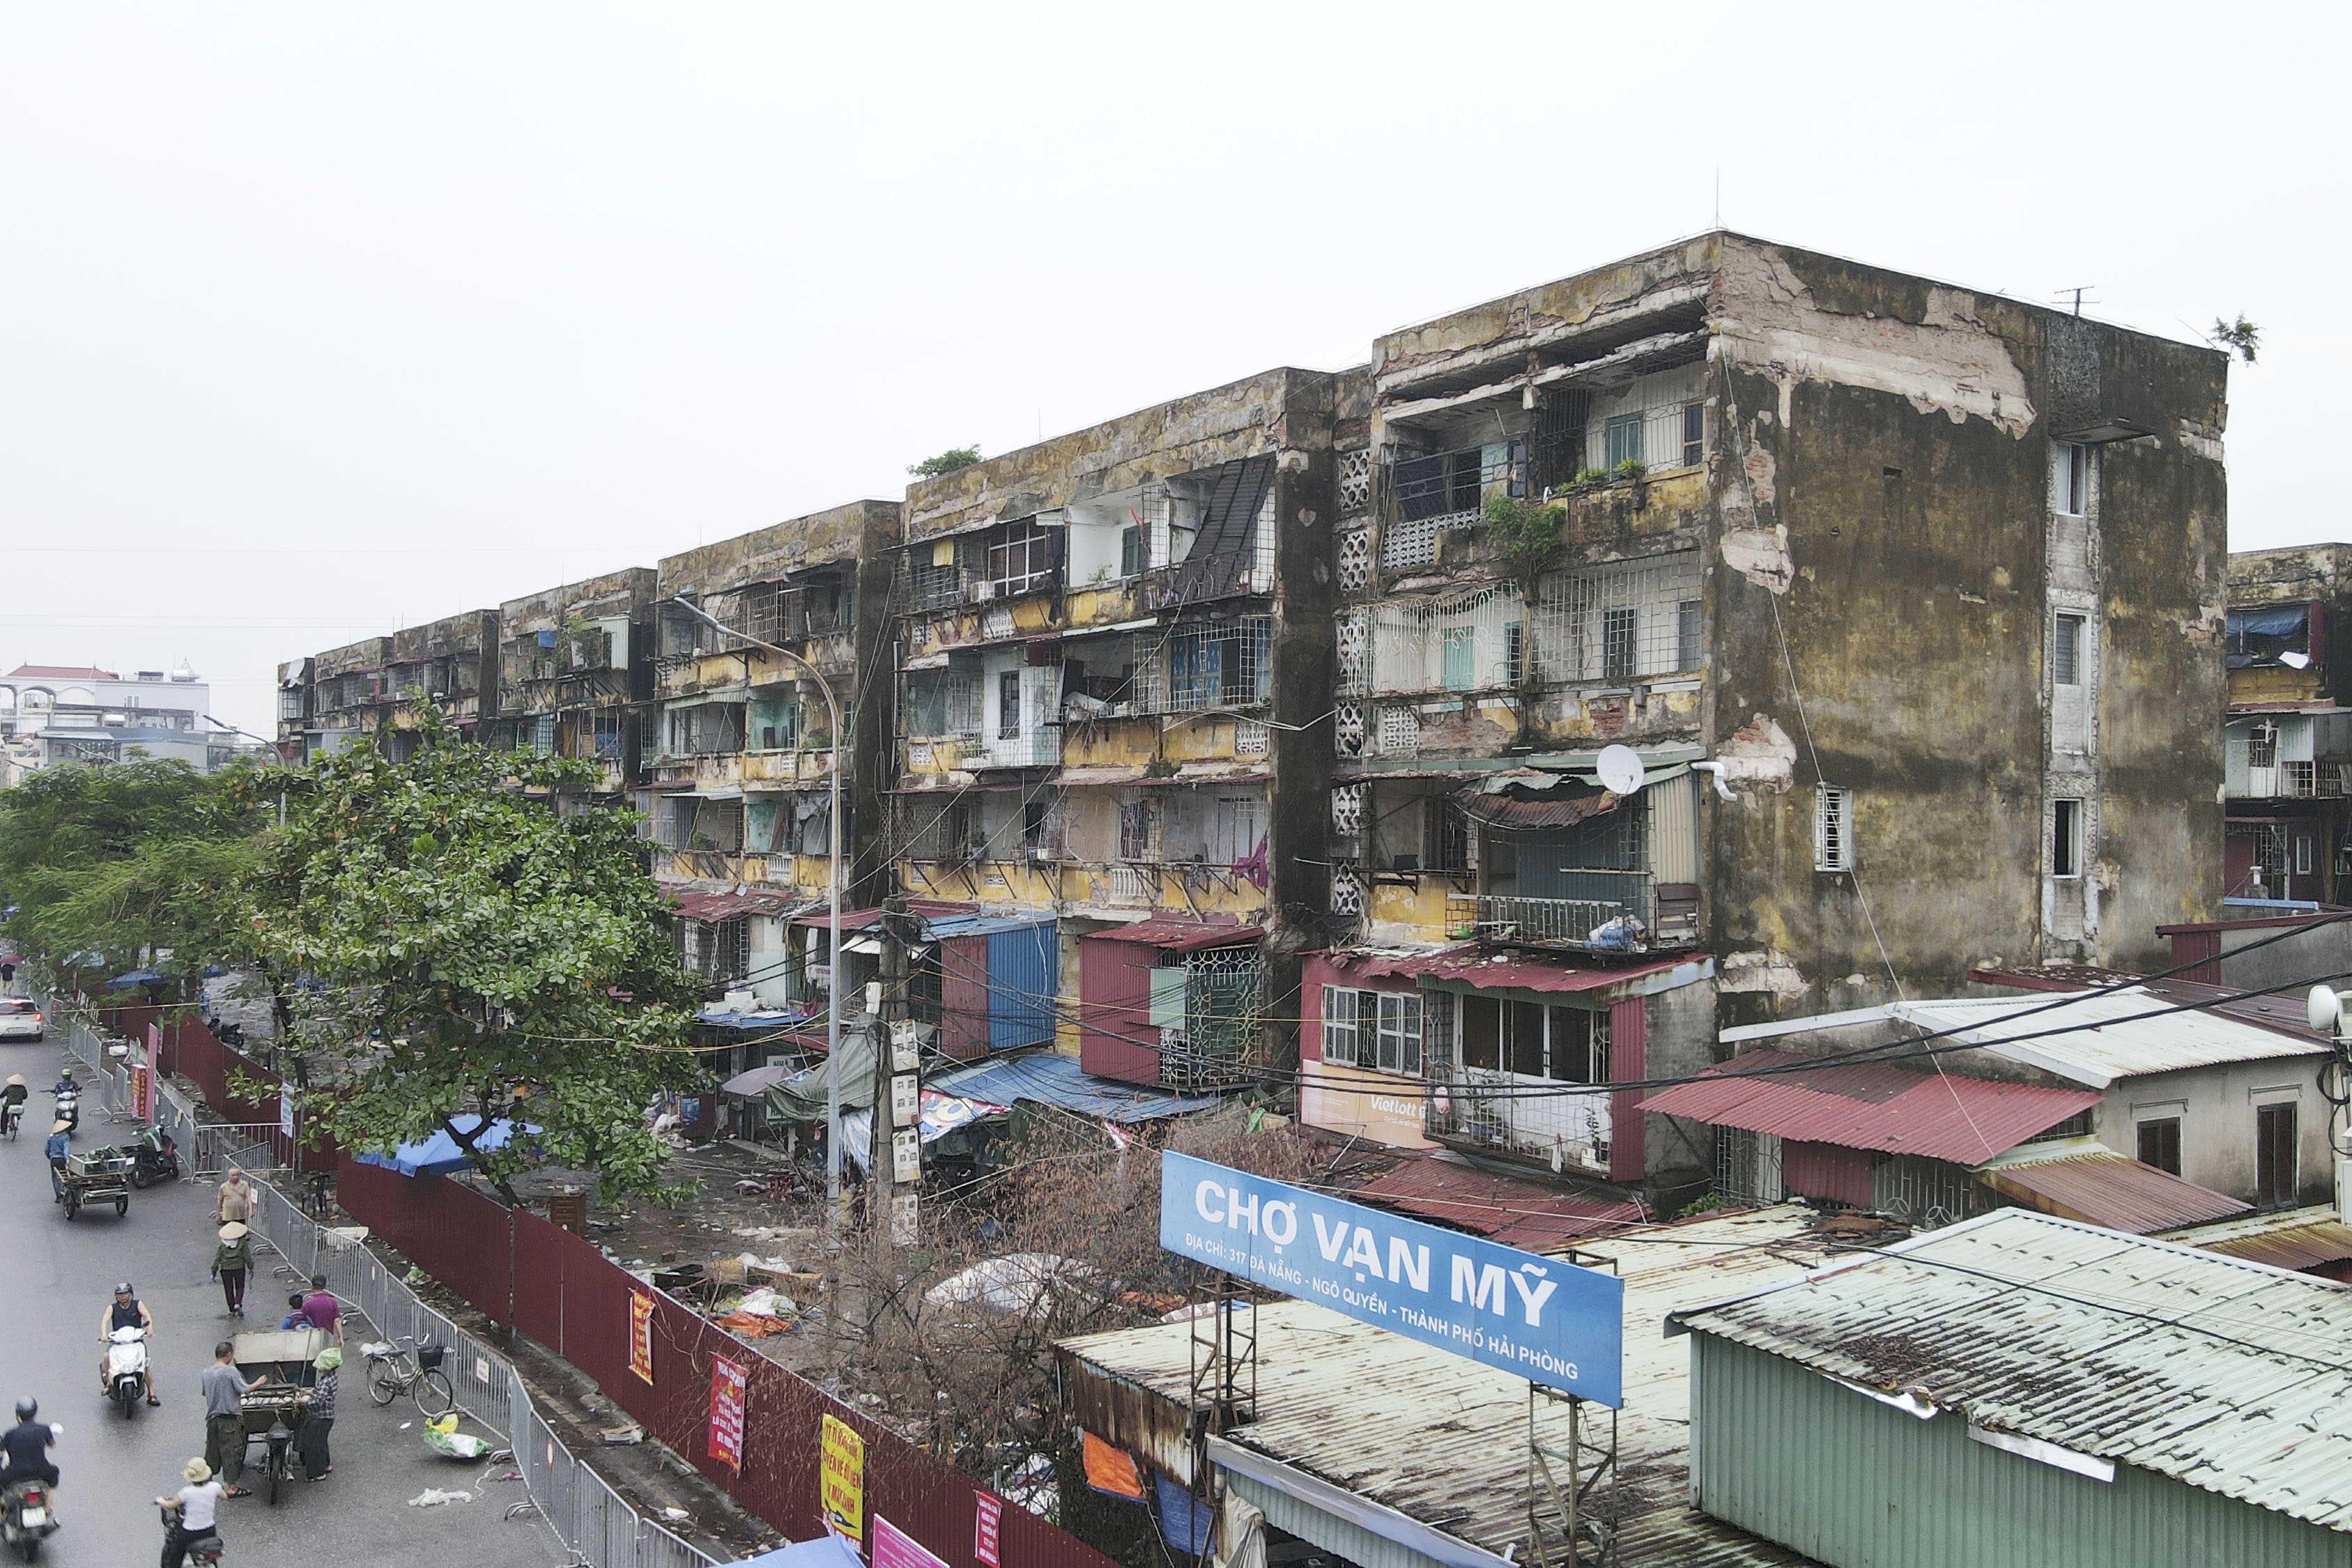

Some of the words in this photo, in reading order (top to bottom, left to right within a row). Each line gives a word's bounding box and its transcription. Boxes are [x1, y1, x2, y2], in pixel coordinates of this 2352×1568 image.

[1371, 1095, 1417, 1117] Vietlott
[1185, 1233, 1203, 1251] ĐỊA
[1205, 1240, 1227, 1259] CHỈ:
[1229, 1248, 1246, 1265] 317
[1250, 1255, 1266, 1273] ĐÀ
[1268, 1259, 1302, 1285] NẴNG
[1312, 1277, 1339, 1298] NGÔ
[1342, 1288, 1387, 1316] QUYỀN
[1399, 1306, 1448, 1337] THÀNH
[1452, 1327, 1484, 1348] PHỐ
[1488, 1335, 1514, 1359] HẢI
[1519, 1346, 1578, 1380] PHÒNG
[1195, 1180, 1297, 1254] CHỢ
[1312, 1212, 1430, 1293] VẠN
[1451, 1254, 1558, 1328] MỸ
